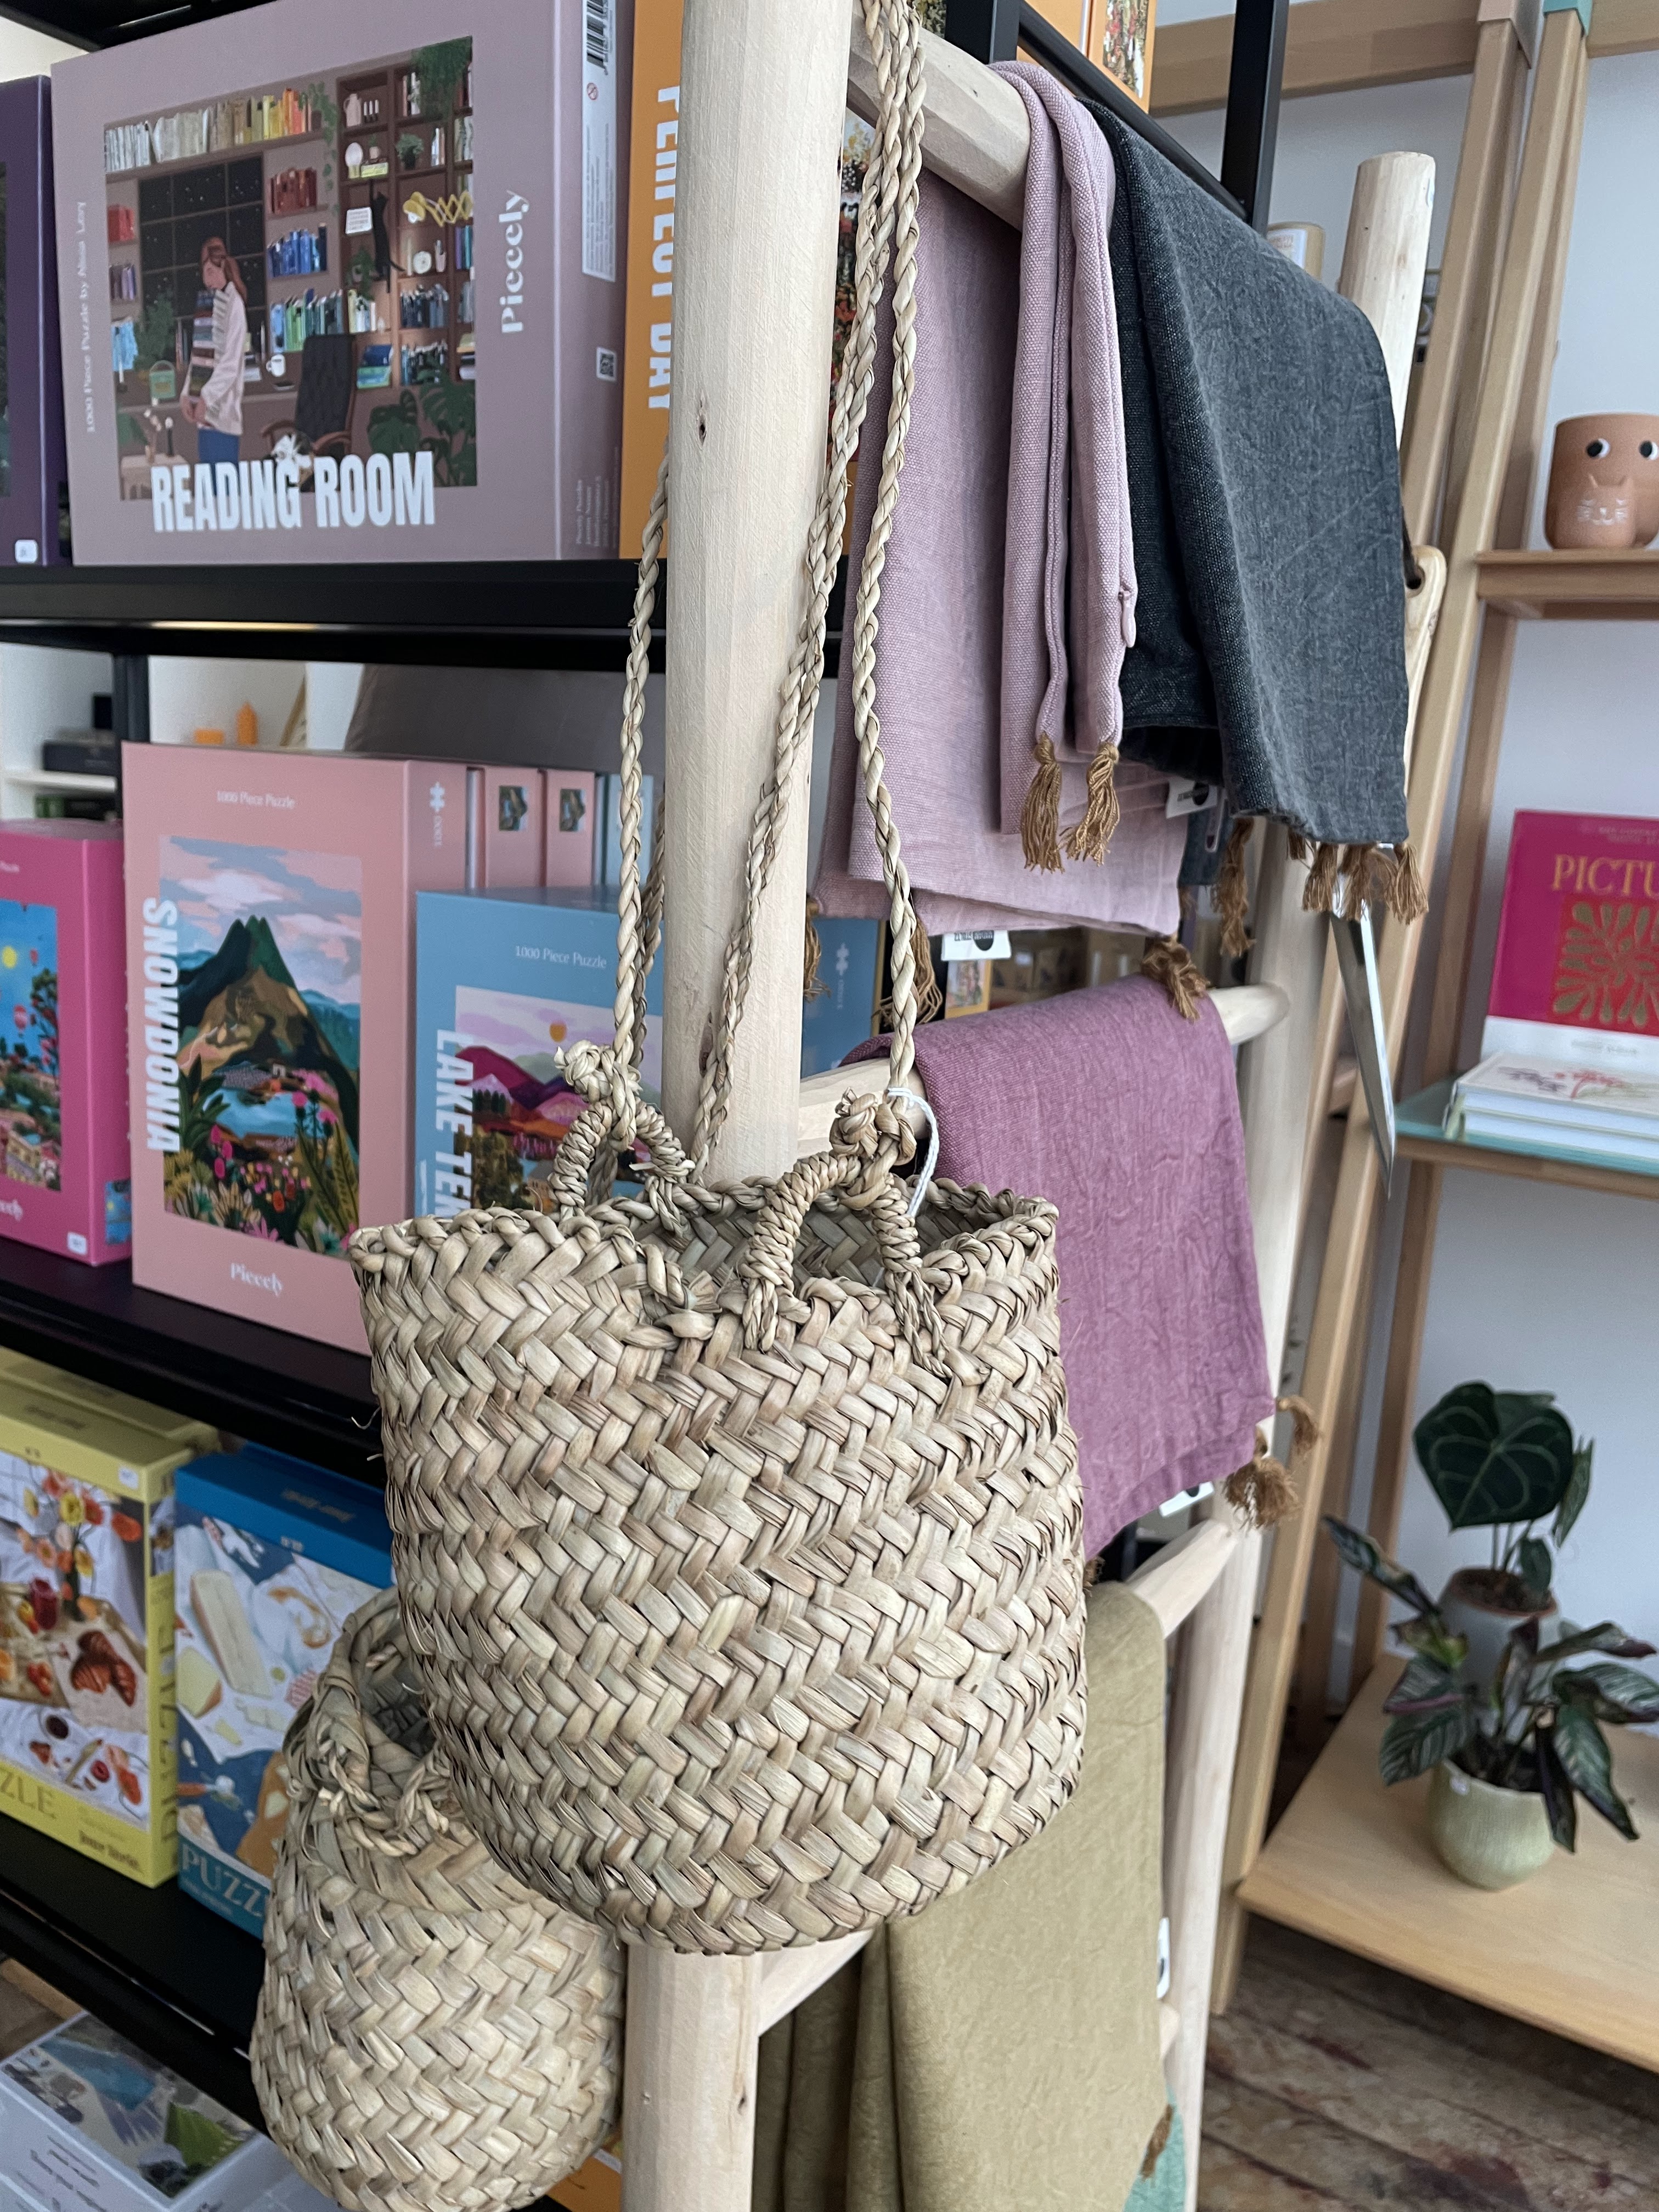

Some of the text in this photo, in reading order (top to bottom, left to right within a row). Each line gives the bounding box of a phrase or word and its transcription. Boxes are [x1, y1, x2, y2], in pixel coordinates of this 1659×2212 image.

[498, 190, 529, 333] Piecely
[80, 302, 91, 351] Puzzle
[151, 450, 436, 533] READING ROOM
[266, 793, 295, 809] Puzzle
[515, 945, 607, 969] 1000 Piece Puzzle
[143, 898, 180, 1153] SNOWDONIA
[436, 1029, 474, 1138] LAKE
